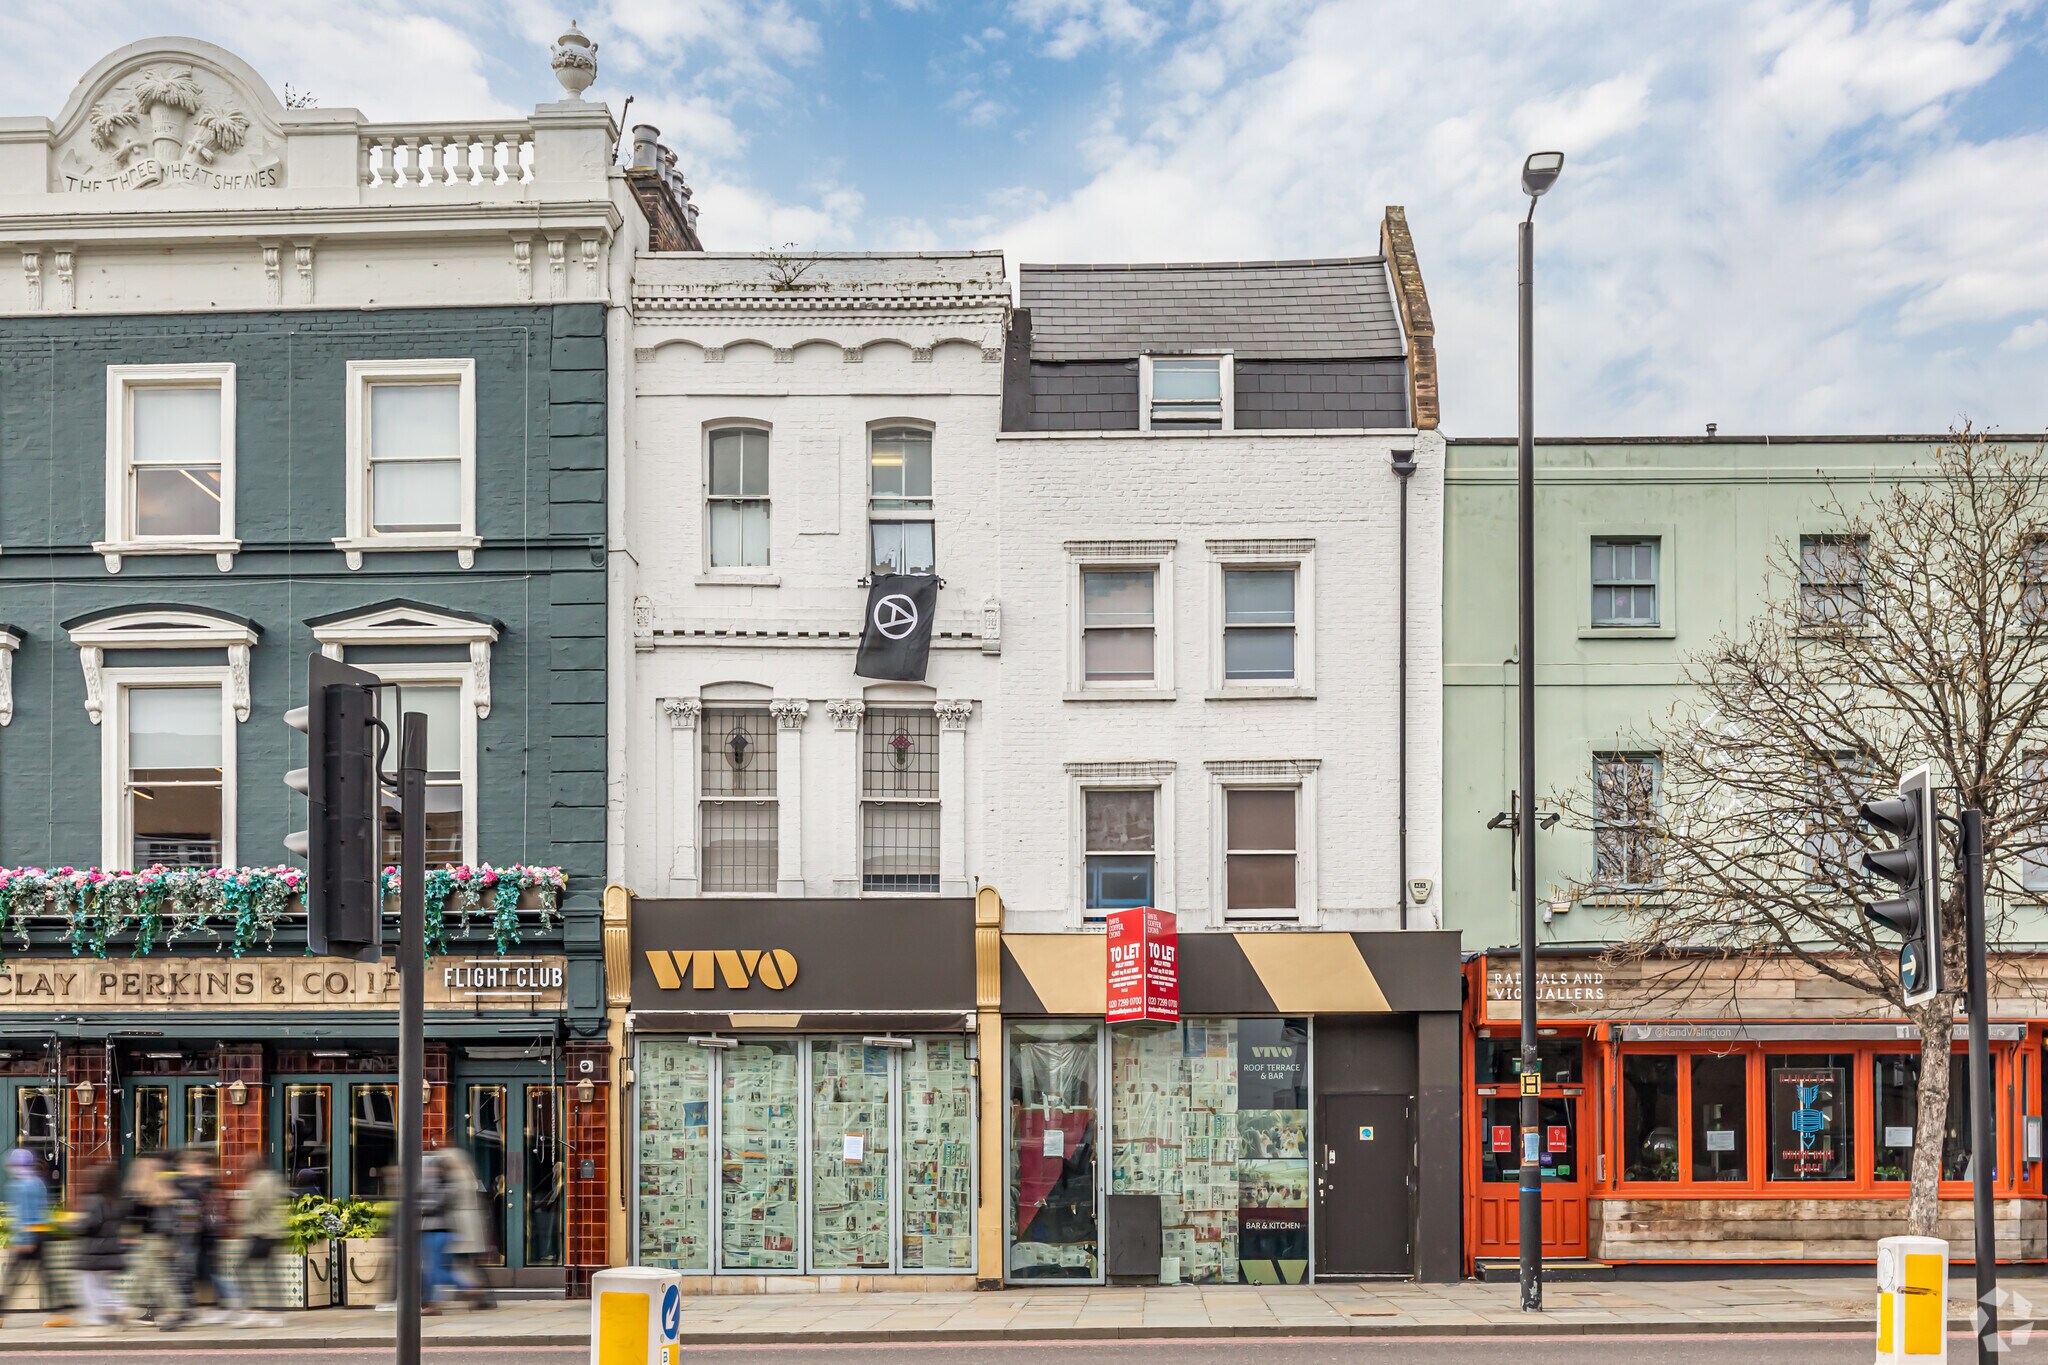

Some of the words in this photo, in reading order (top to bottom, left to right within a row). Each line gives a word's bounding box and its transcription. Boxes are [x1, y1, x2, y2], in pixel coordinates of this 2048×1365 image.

[66, 175, 102, 192] THE
[106, 160, 157, 192] THREE
[213, 168, 277, 190] SHEAVES
[1110, 946, 1122, 963] TO
[1123, 942, 1141, 961] LET
[1148, 942, 1160, 959] TO
[1161, 944, 1175, 962] LET
[645, 948, 799, 990] VIVO
[100, 972, 254, 996] PERKINS
[271, 976, 286, 995] &
[443, 967, 510, 988] FLIGHT
[516, 967, 563, 988] CLUB
[1573, 973, 1604, 985] AND
[1251, 1046, 1293, 1058] VIVO
[1243, 1064, 1265, 1072] ROOF
[1266, 1064, 1301, 1072] TERRACE
[1260, 1072, 1267, 1080] &
[1268, 1072, 1284, 1080] BAR
[1782, 1150, 1810, 1160] DRINK
[1813, 1150, 1835, 1160] DINE
[1246, 1221, 1261, 1230] BAR
[1261, 1221, 1268, 1230] &
[1269, 1221, 1301, 1230] KITCHEN
